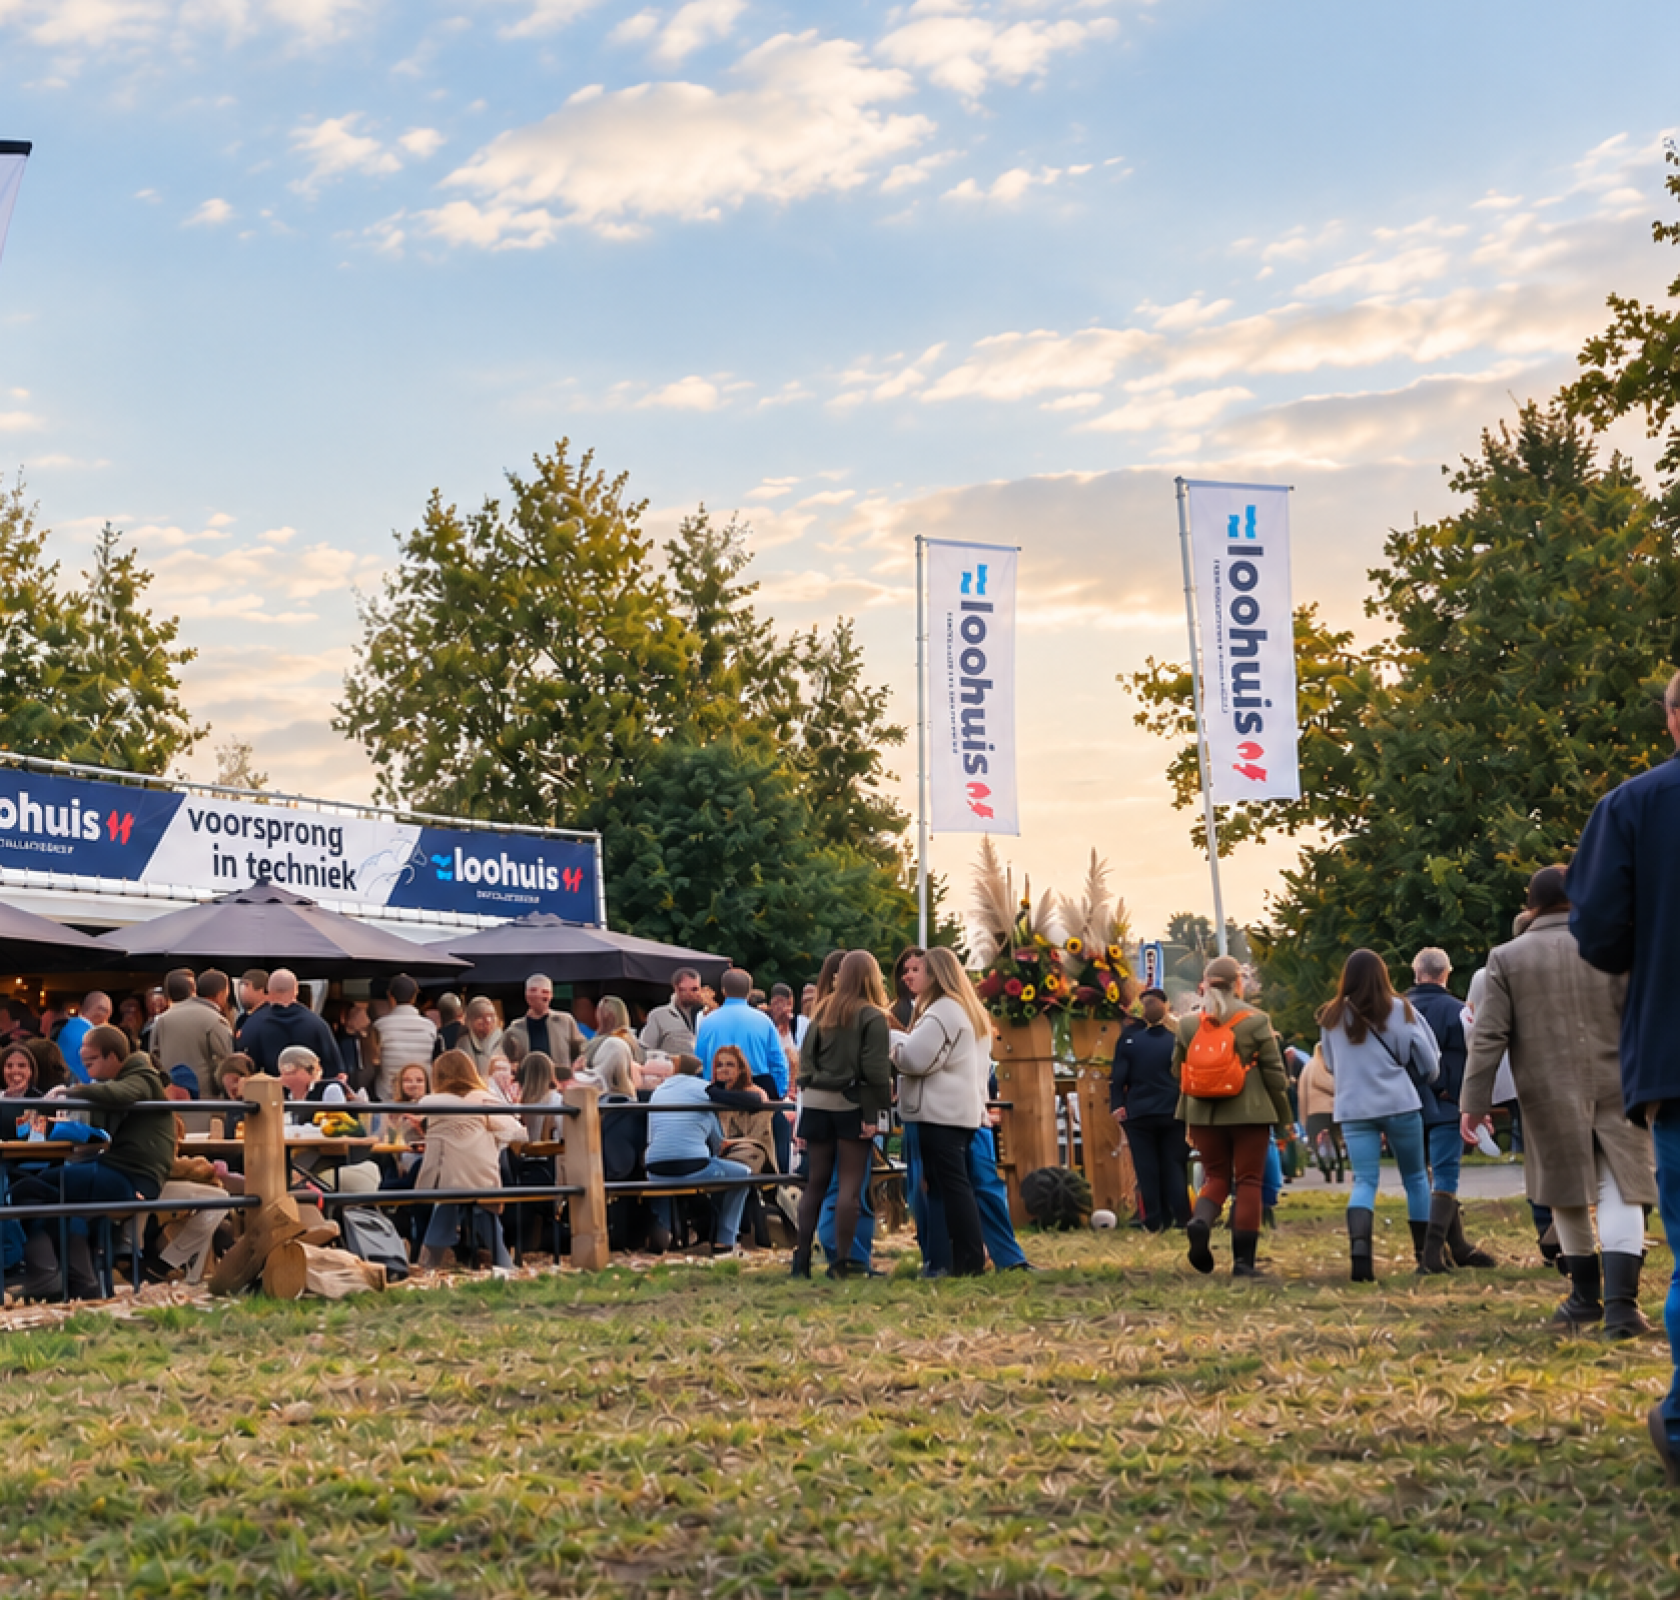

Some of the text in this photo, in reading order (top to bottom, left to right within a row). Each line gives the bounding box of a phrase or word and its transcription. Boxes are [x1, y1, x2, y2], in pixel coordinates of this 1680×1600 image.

[1227, 545, 1273, 736] loohuis
[960, 600, 995, 776] loohuis
[187, 808, 343, 858] voorsprong
[213, 842, 357, 891] in techniek
[454, 846, 560, 892] loohuis
